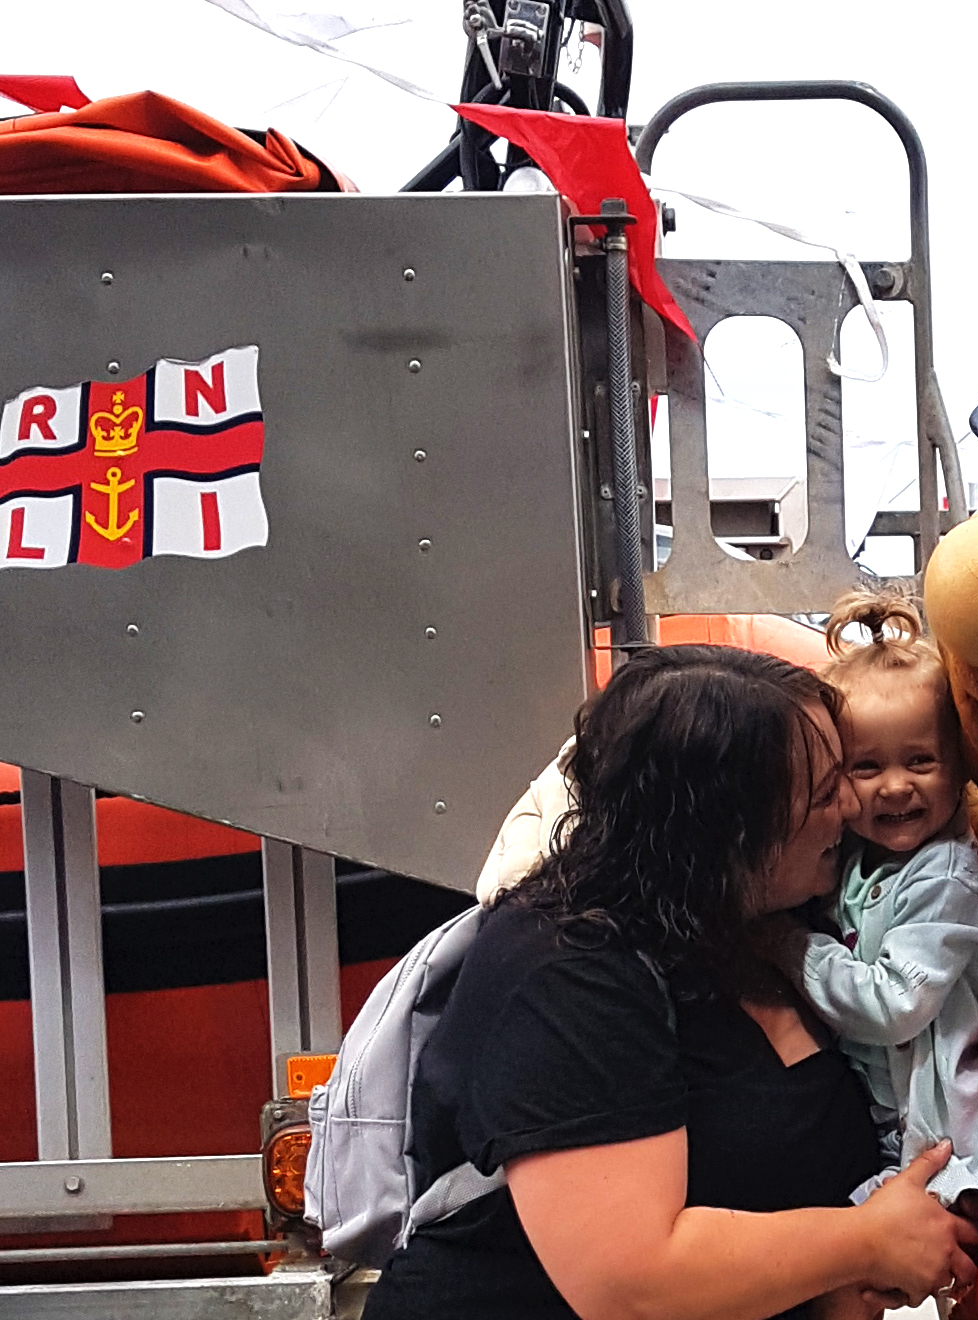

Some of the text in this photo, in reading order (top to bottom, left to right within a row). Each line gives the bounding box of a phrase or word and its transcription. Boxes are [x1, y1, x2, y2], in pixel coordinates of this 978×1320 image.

[18, 361, 227, 441] R N
[6, 492, 222, 559] L I
